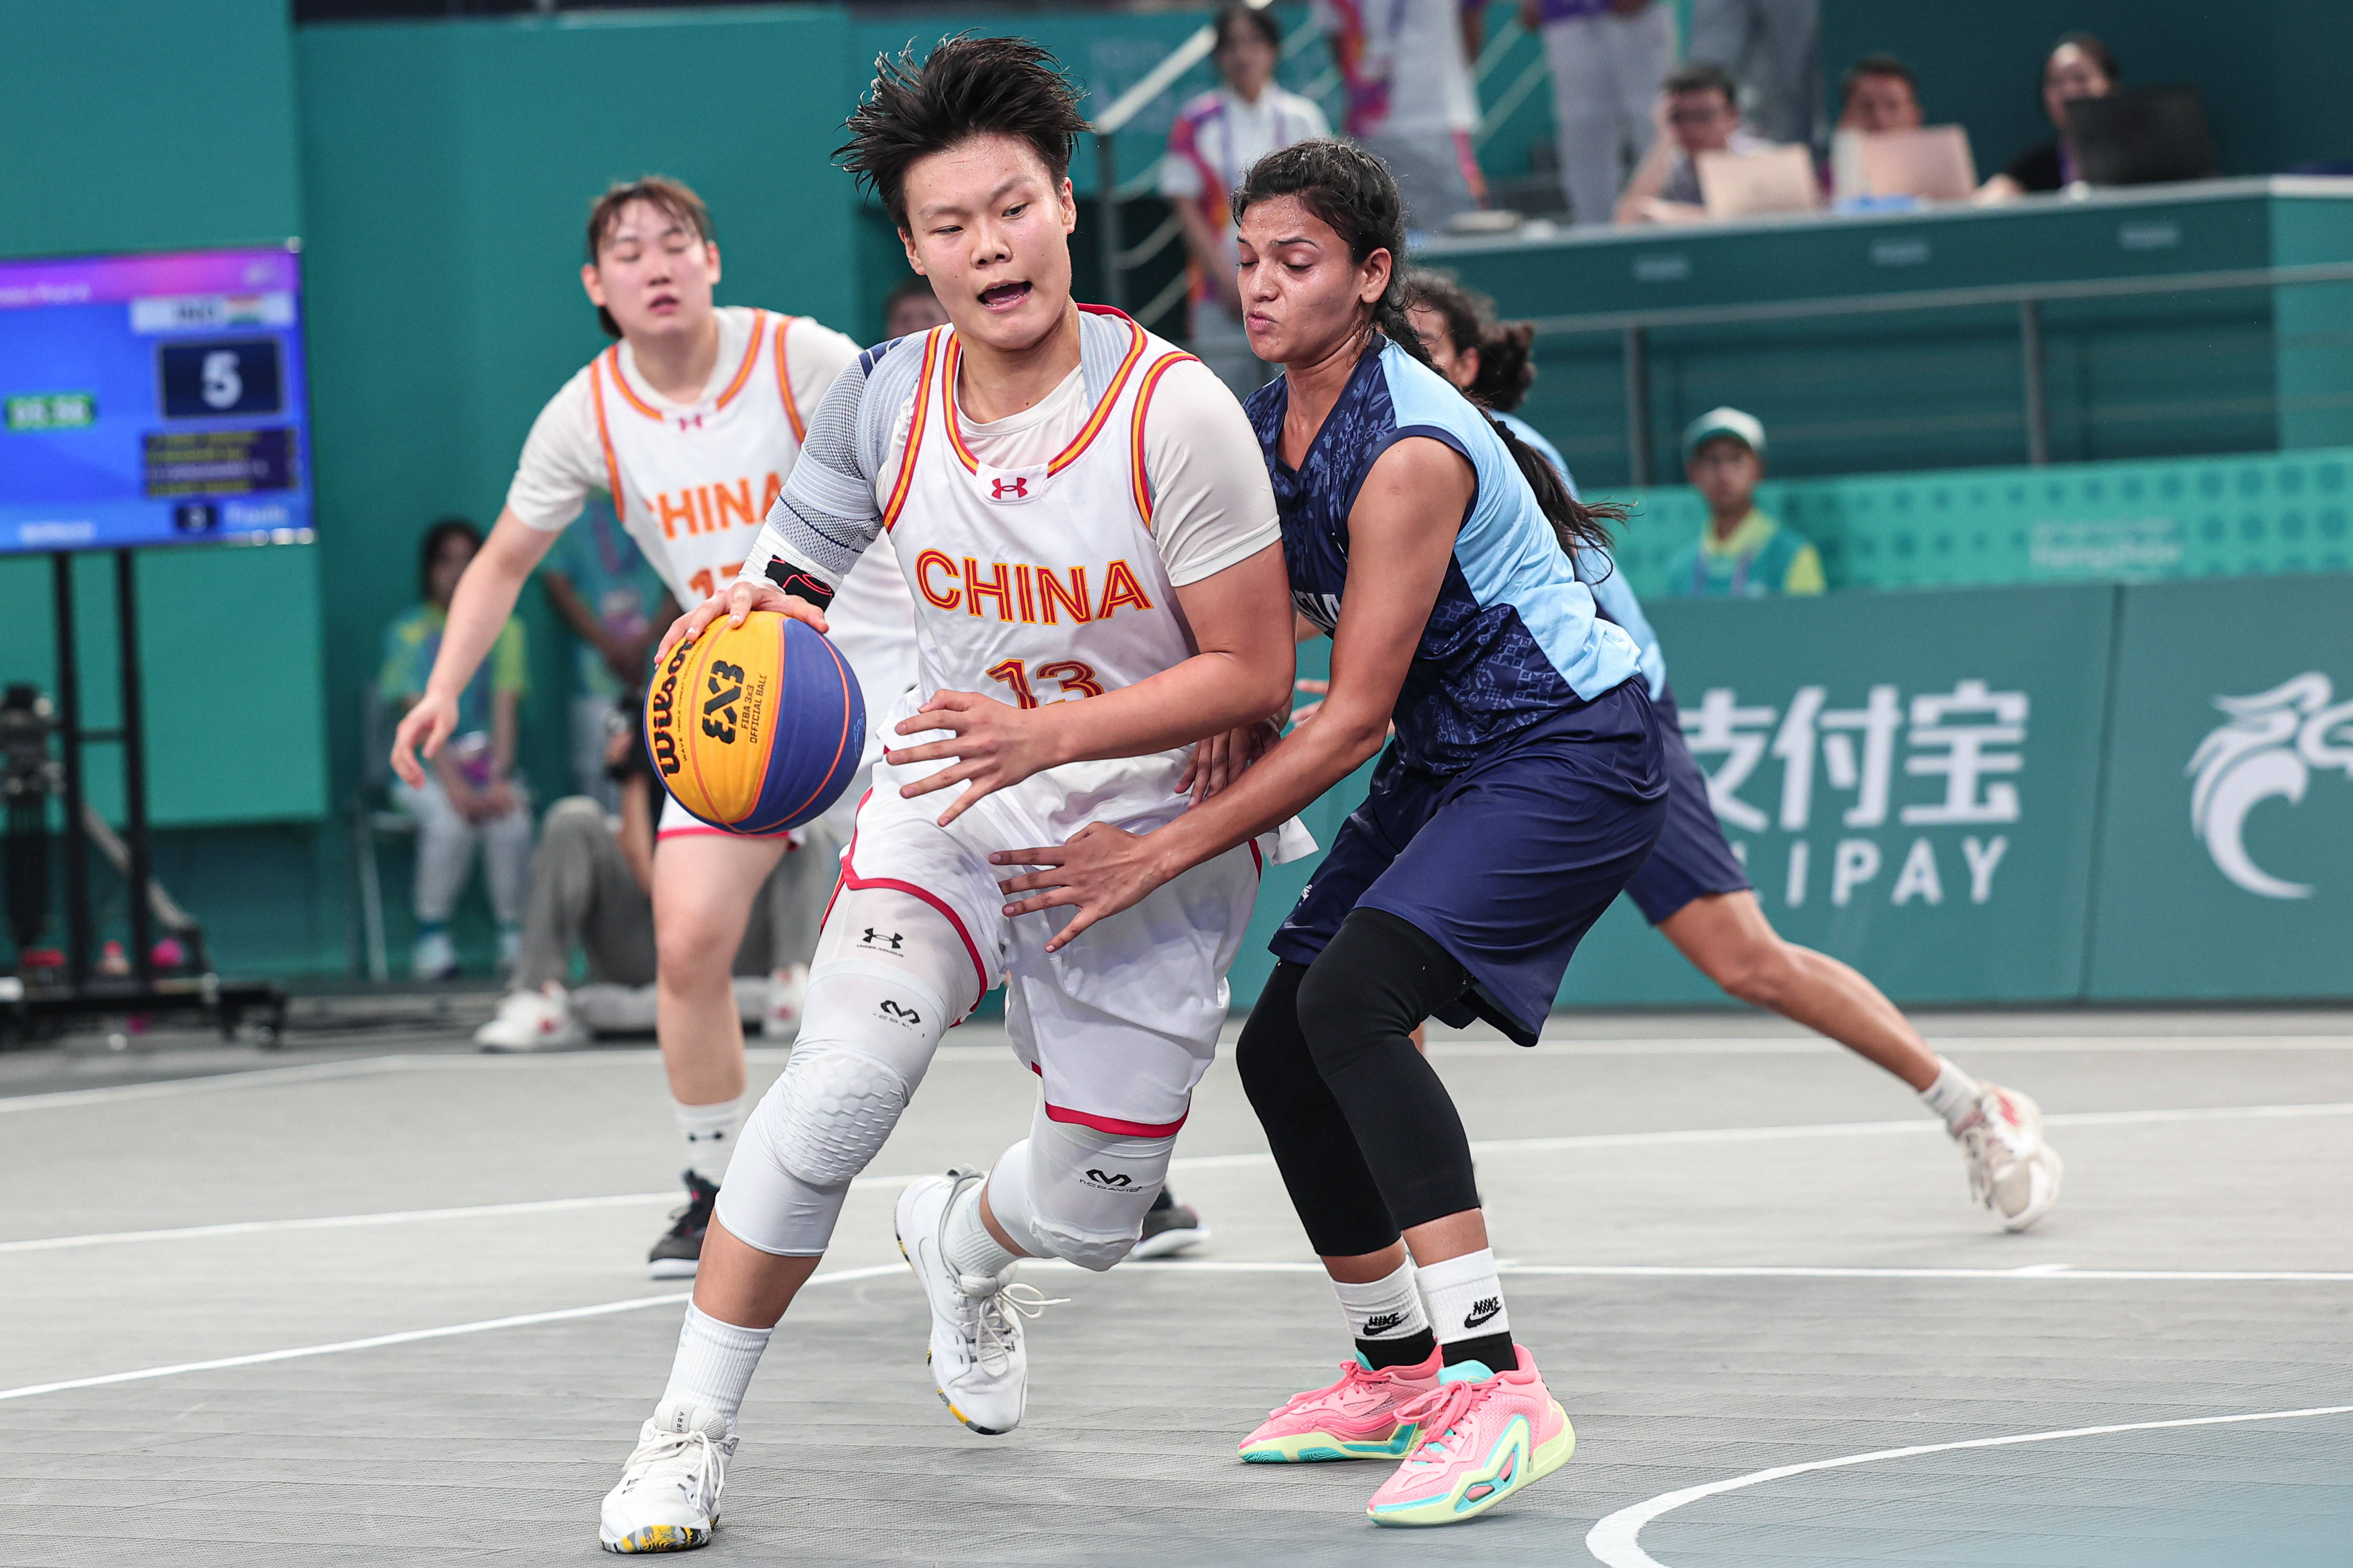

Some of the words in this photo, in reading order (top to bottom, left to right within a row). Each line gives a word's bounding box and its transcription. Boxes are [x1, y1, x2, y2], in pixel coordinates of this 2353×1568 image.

[201, 350, 243, 409] 5
[643, 470, 781, 540] HINA
[915, 548, 1154, 625] CHINA
[750, 699, 762, 743] OFFICIAL
[756, 675, 767, 696] BALL
[985, 658, 1105, 709] 13
[741, 706, 750, 729] FIBA
[679, 738, 687, 762] WAVE
[1678, 679, 2029, 832] 支付宝
[1732, 837, 2007, 907] IPAY
[1369, 1312, 1399, 1326] NIKE
[1474, 1296, 1500, 1316] NIKE
[676, 1411, 685, 1432] URRY
